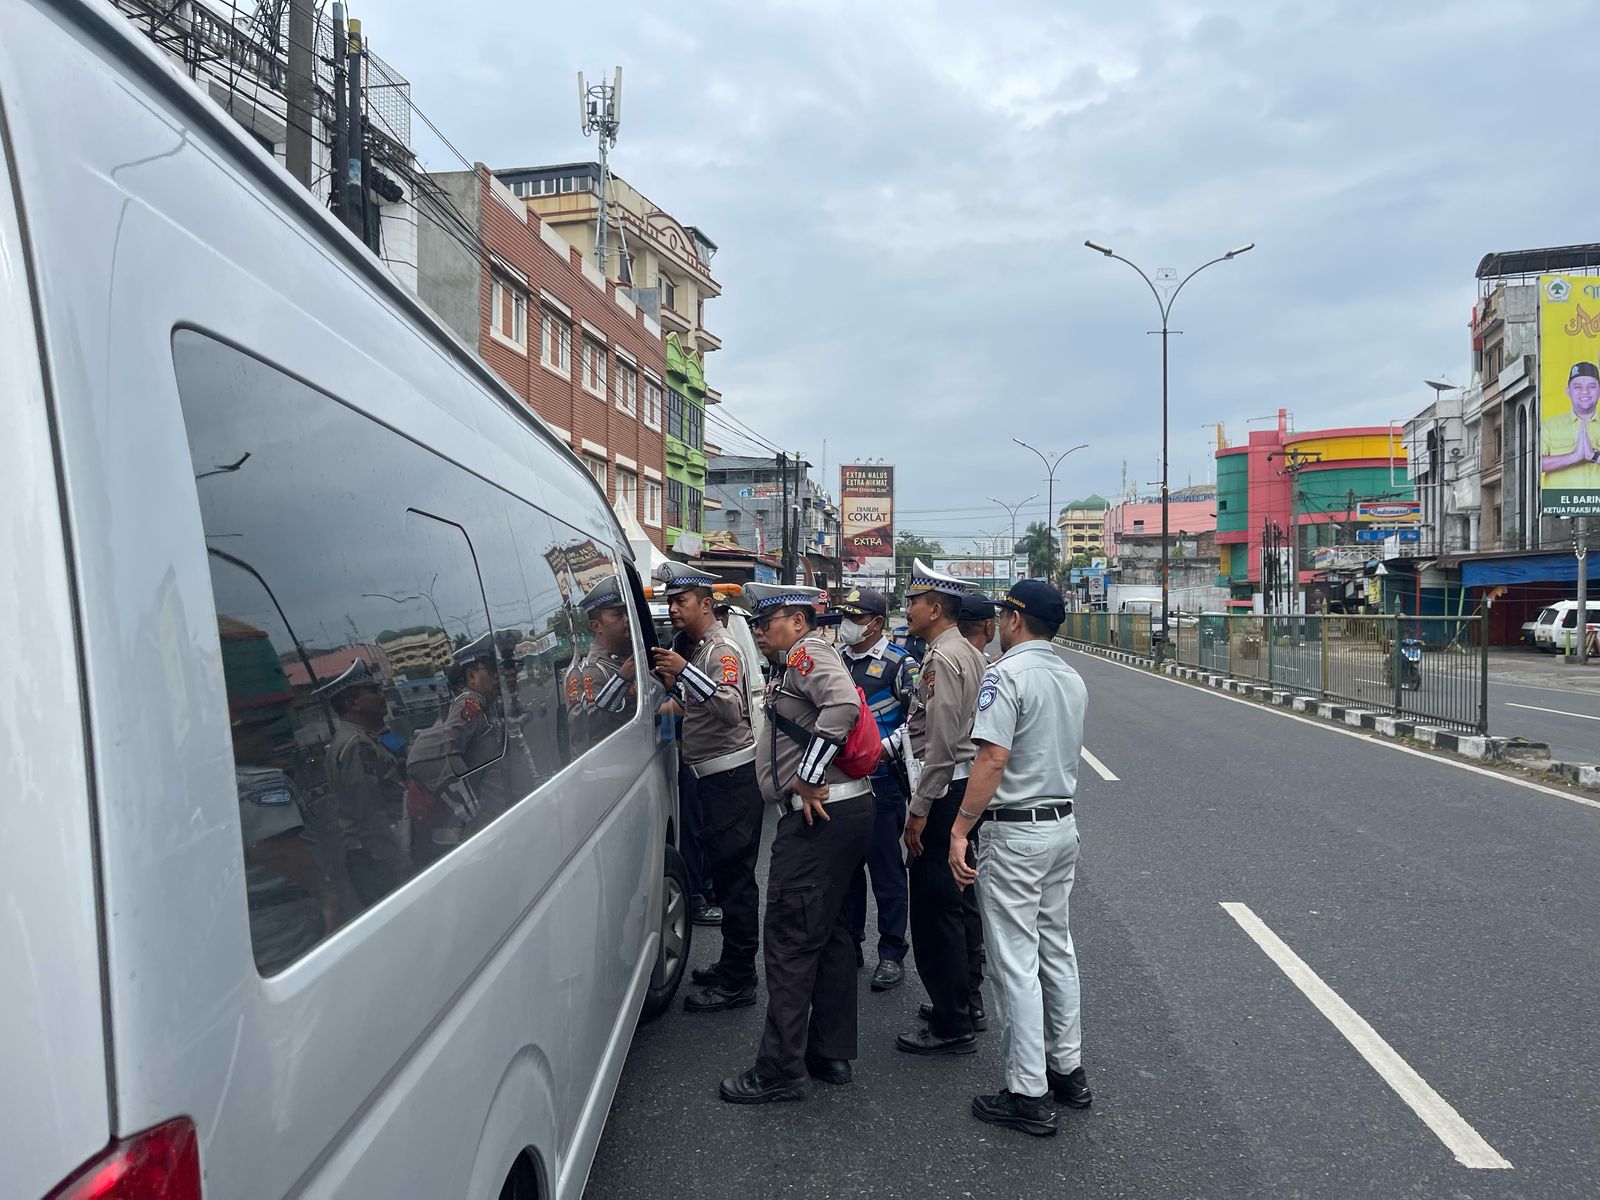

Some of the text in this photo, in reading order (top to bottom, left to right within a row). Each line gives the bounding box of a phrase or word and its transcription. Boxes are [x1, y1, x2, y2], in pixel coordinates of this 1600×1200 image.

[1560, 495, 1570, 504] EL
[1543, 506, 1566, 514] KETUA
[1566, 506, 1591, 514] FRAKSI
[848, 513, 887, 522] COKLAT
[854, 538, 882, 546] EXTRA
